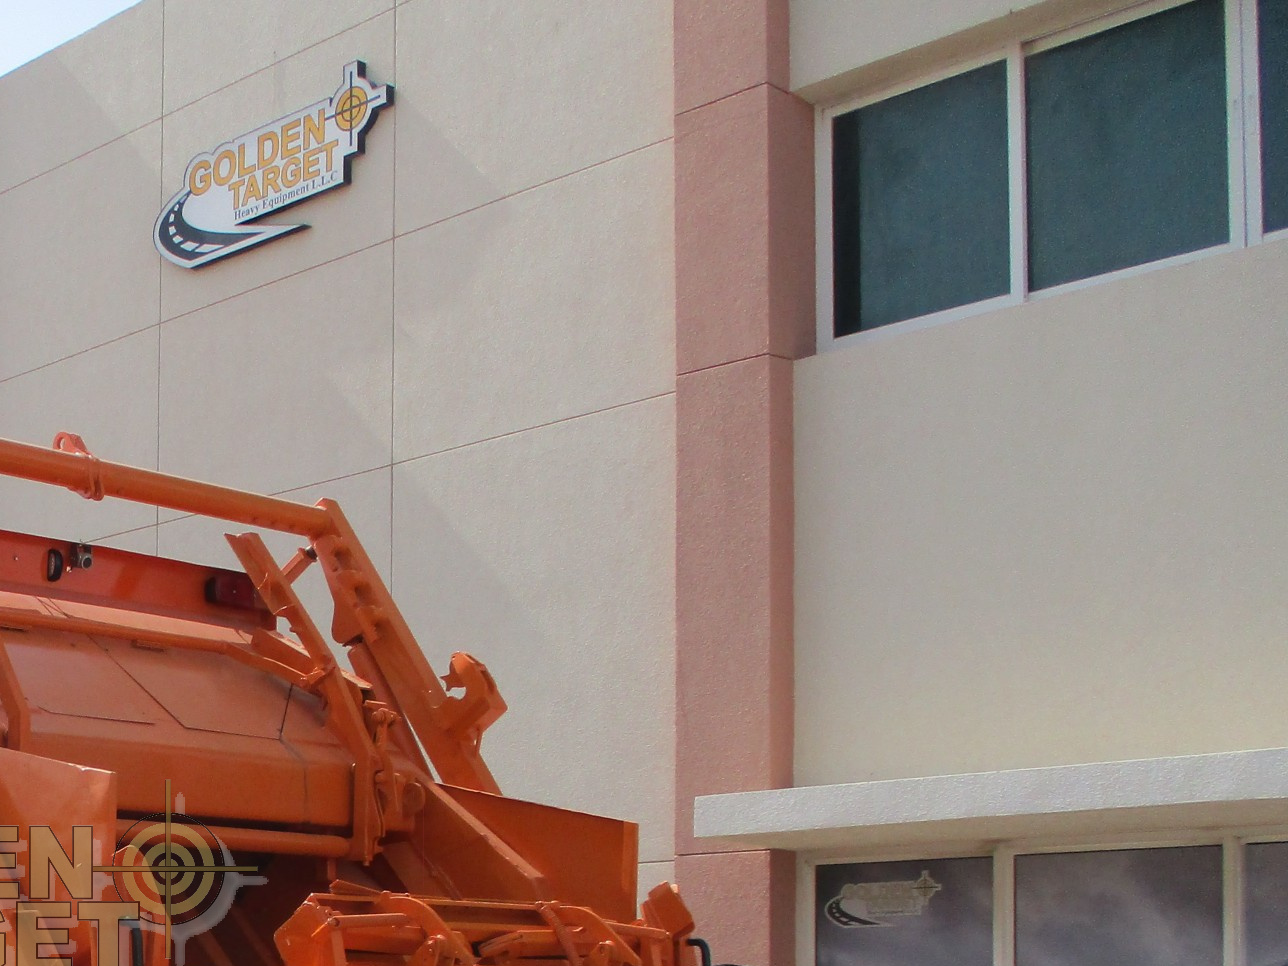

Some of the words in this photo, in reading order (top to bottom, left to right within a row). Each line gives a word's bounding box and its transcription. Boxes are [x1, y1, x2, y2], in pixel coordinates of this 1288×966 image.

[189, 108, 326, 196] GOLDEN
[229, 139, 339, 210] TARGET
[234, 204, 260, 221] Heavy
[262, 185, 310, 210] Equipment
[312, 171, 338, 190] L.L.C
